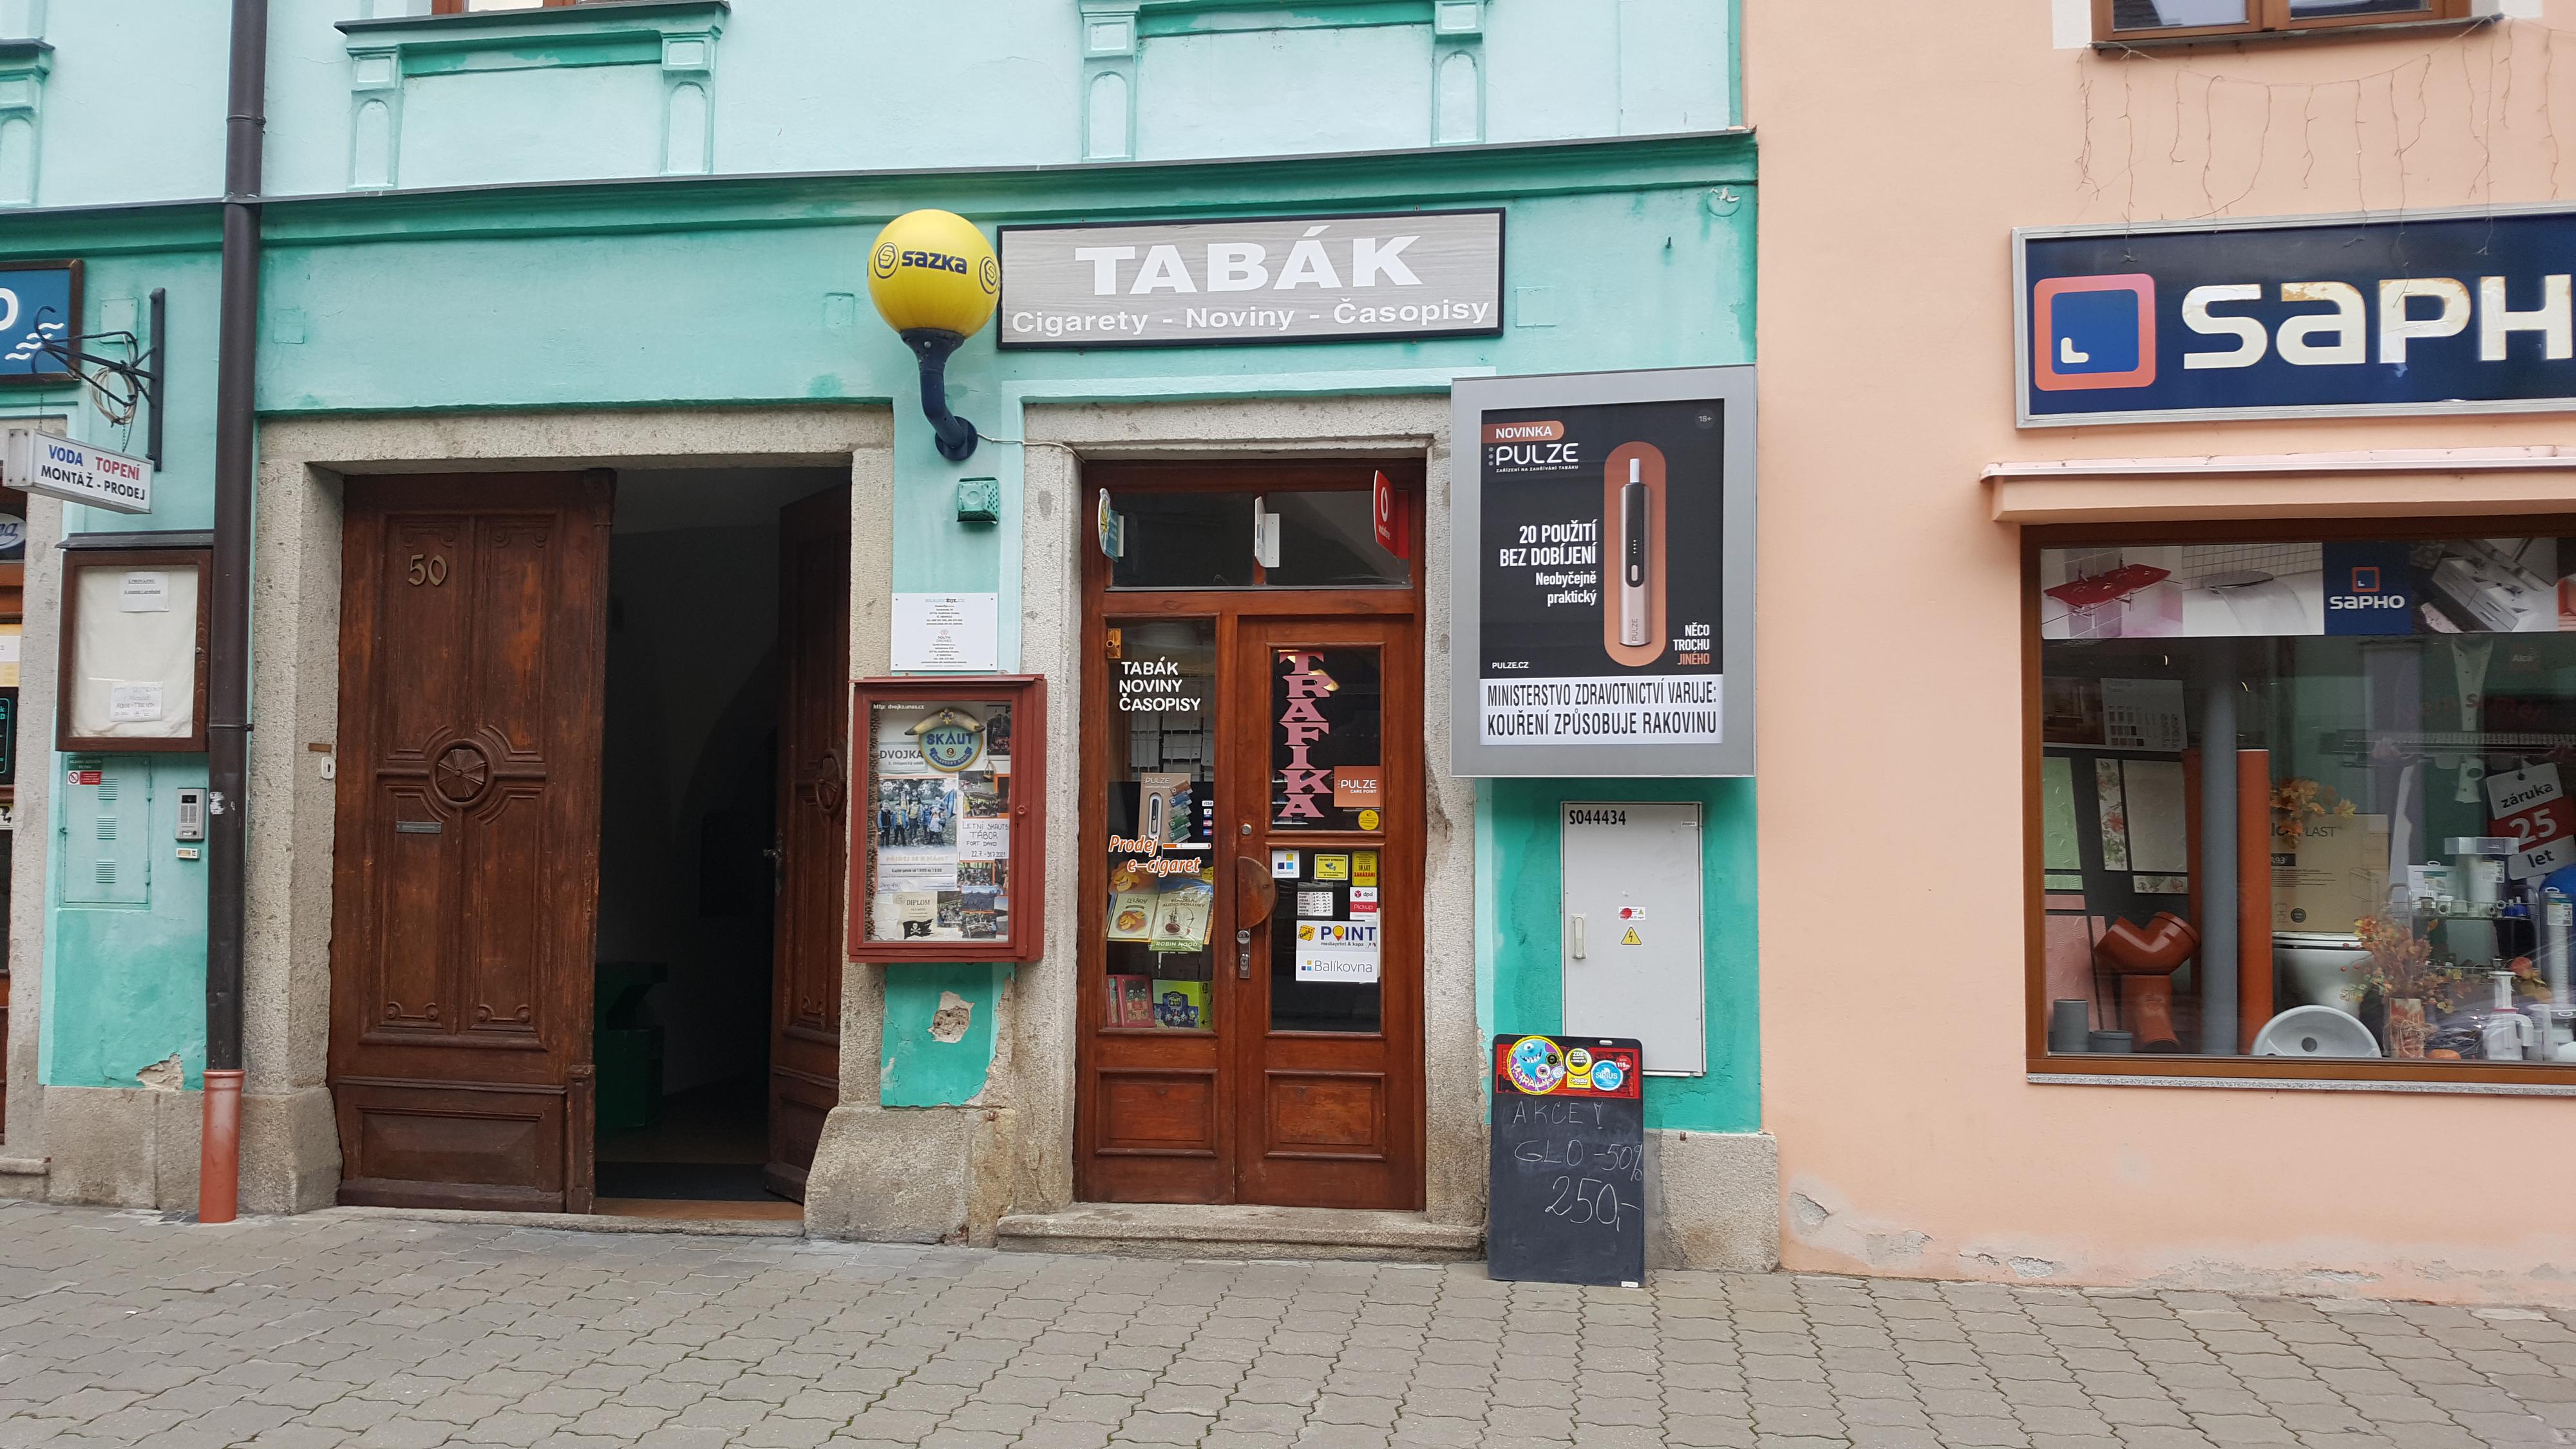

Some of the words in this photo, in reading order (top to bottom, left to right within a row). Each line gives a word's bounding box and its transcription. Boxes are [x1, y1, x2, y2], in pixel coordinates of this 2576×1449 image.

[1074, 225, 1423, 296] TABÁK
[1012, 310, 1148, 337] Cigarety
[1186, 305, 1295, 332] Noviny
[1333, 298, 1490, 327] Časopisy
[1496, 426, 1553, 439] NOVINKA
[48, 444, 83, 467] VODA
[95, 456, 140, 480] TOPENÍ
[1496, 442, 1579, 466] PULZE
[41, 465, 94, 489] MONTÁŽ
[104, 480, 145, 500] PRODEJ
[1519, 526, 1537, 544] 20
[1541, 518, 1598, 544] POUŽITÍ
[1500, 549, 1527, 568] BEZ
[1530, 542, 1597, 567] DOBÍJENÍ
[408, 553, 448, 587] 50
[1535, 571, 1597, 588] Neobyčejně
[1547, 591, 1597, 608] praktický
[1685, 623, 1710, 637] NĚCO
[1673, 638, 1710, 652] TROCHU
[1121, 656, 1179, 676] TABÁK
[1492, 661, 1530, 669] PULZE.CZ
[1677, 651, 1710, 666] JINÉHO
[1119, 679, 1182, 693] NOVINY
[1487, 684, 1571, 708] MINISTERSTVO
[1575, 678, 1665, 706] ZDRAVOTNICTVÍ
[1669, 683, 1717, 705] VARUJE:
[1119, 692, 1201, 712] ČASOPISY
[1487, 709, 1549, 737] KOUŘENÍ
[1554, 708, 1637, 735] ZPŮSOBUJE
[1642, 712, 1717, 734] RAKOVINU
[927, 732, 974, 745] SKAUT
[1278, 650, 1333, 817] TRAFIKA
[880, 750, 923, 759] DVOJKA
[1341, 779, 1377, 789] PULZE
[2501, 783, 2553, 809] záruka
[962, 820, 984, 829] LETNÍ
[969, 829, 998, 840] TÁBOR
[2509, 808, 2558, 847] 25
[1109, 835, 1159, 857] Prodej
[1127, 856, 1202, 877] e-cigaret
[2527, 849, 2555, 867] let
[1320, 925, 1376, 941] POINT
[1314, 960, 1372, 973] Balíkovna
[1513, 1101, 1583, 1124] AKCE
[1514, 1139, 1584, 1166] GLO
[1594, 1144, 1643, 1181] -50%
[1545, 1175, 1641, 1232] 250,-
